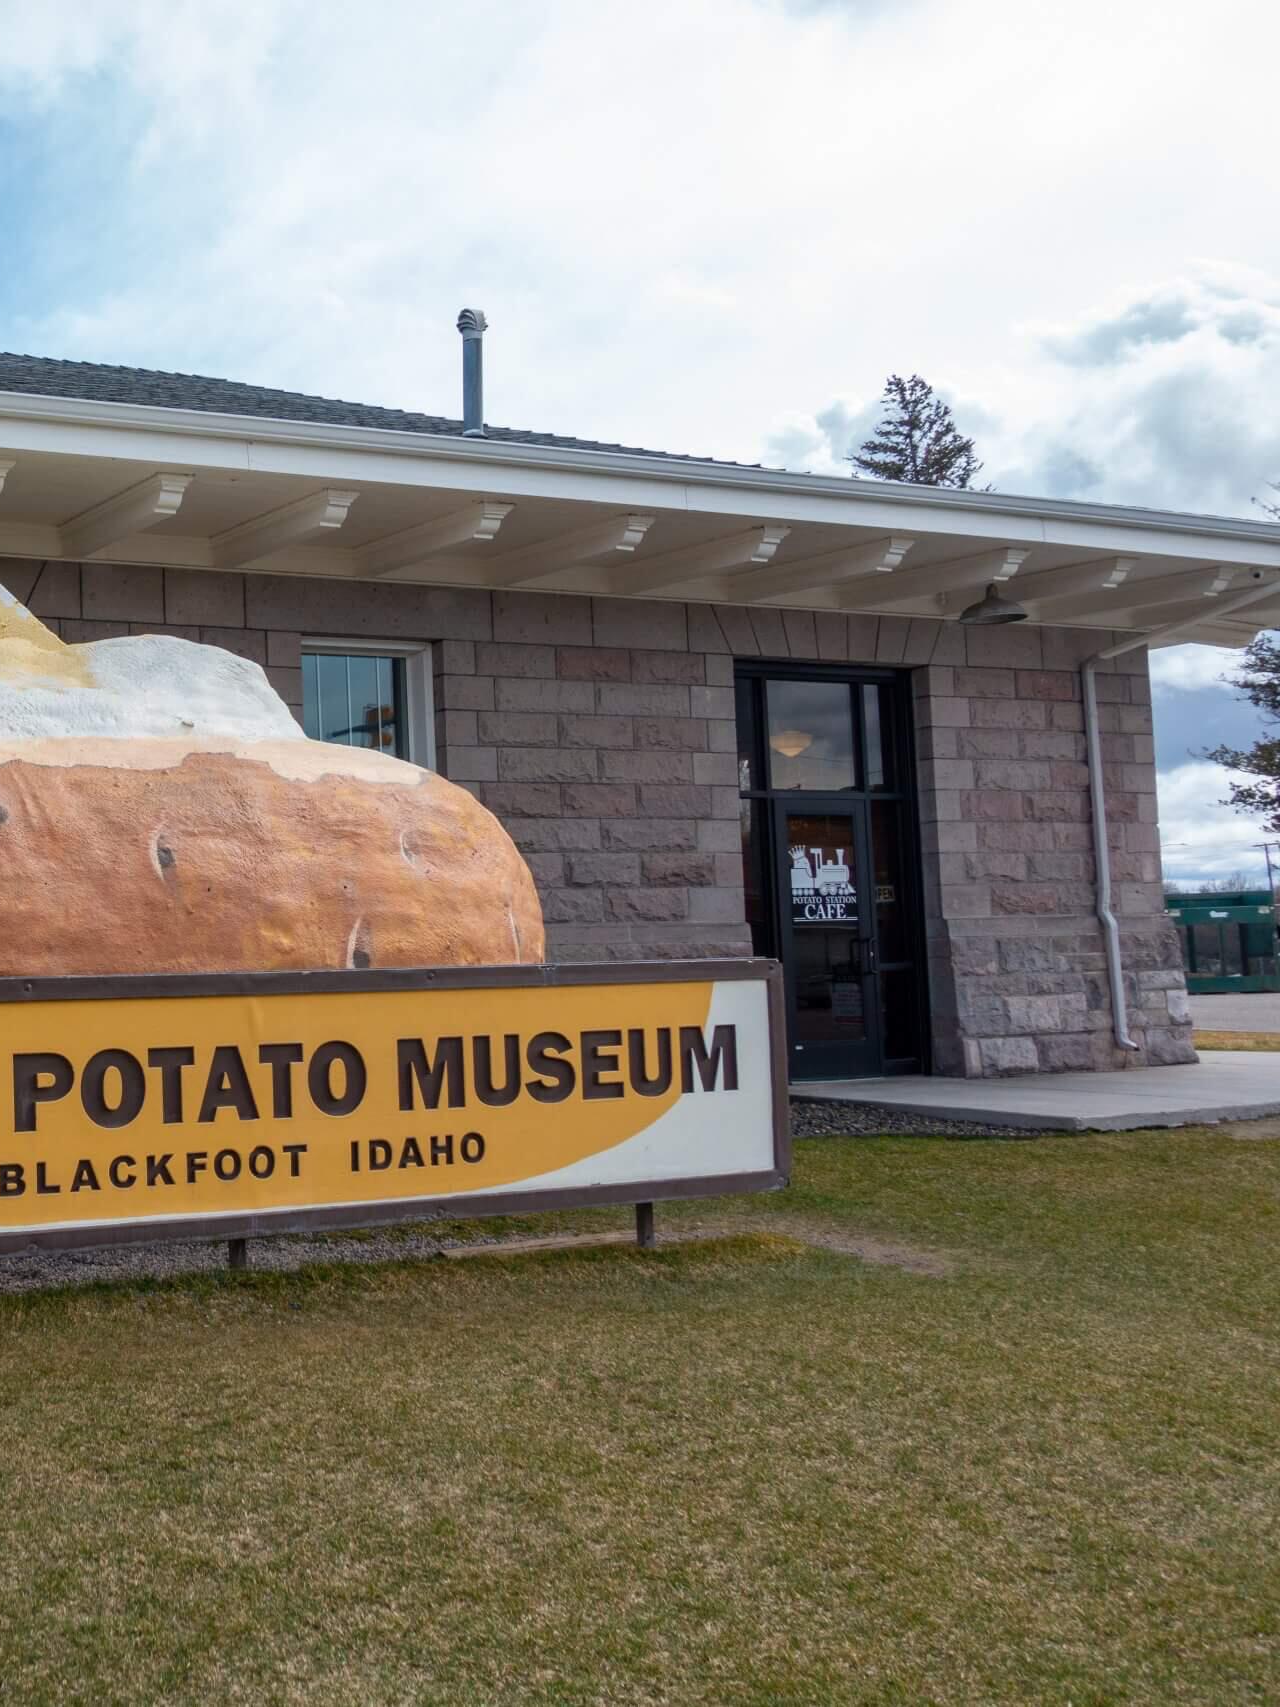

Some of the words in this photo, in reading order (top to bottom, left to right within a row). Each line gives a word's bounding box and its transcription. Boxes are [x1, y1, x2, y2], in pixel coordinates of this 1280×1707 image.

[792, 896, 822, 904] POTATO
[825, 896, 857, 904] STATION
[804, 903, 847, 919] CAFE
[12, 1040, 368, 1133] POTATO
[396, 1023, 739, 1112] MUSEUM
[350, 1131, 486, 1172] IDAHO
